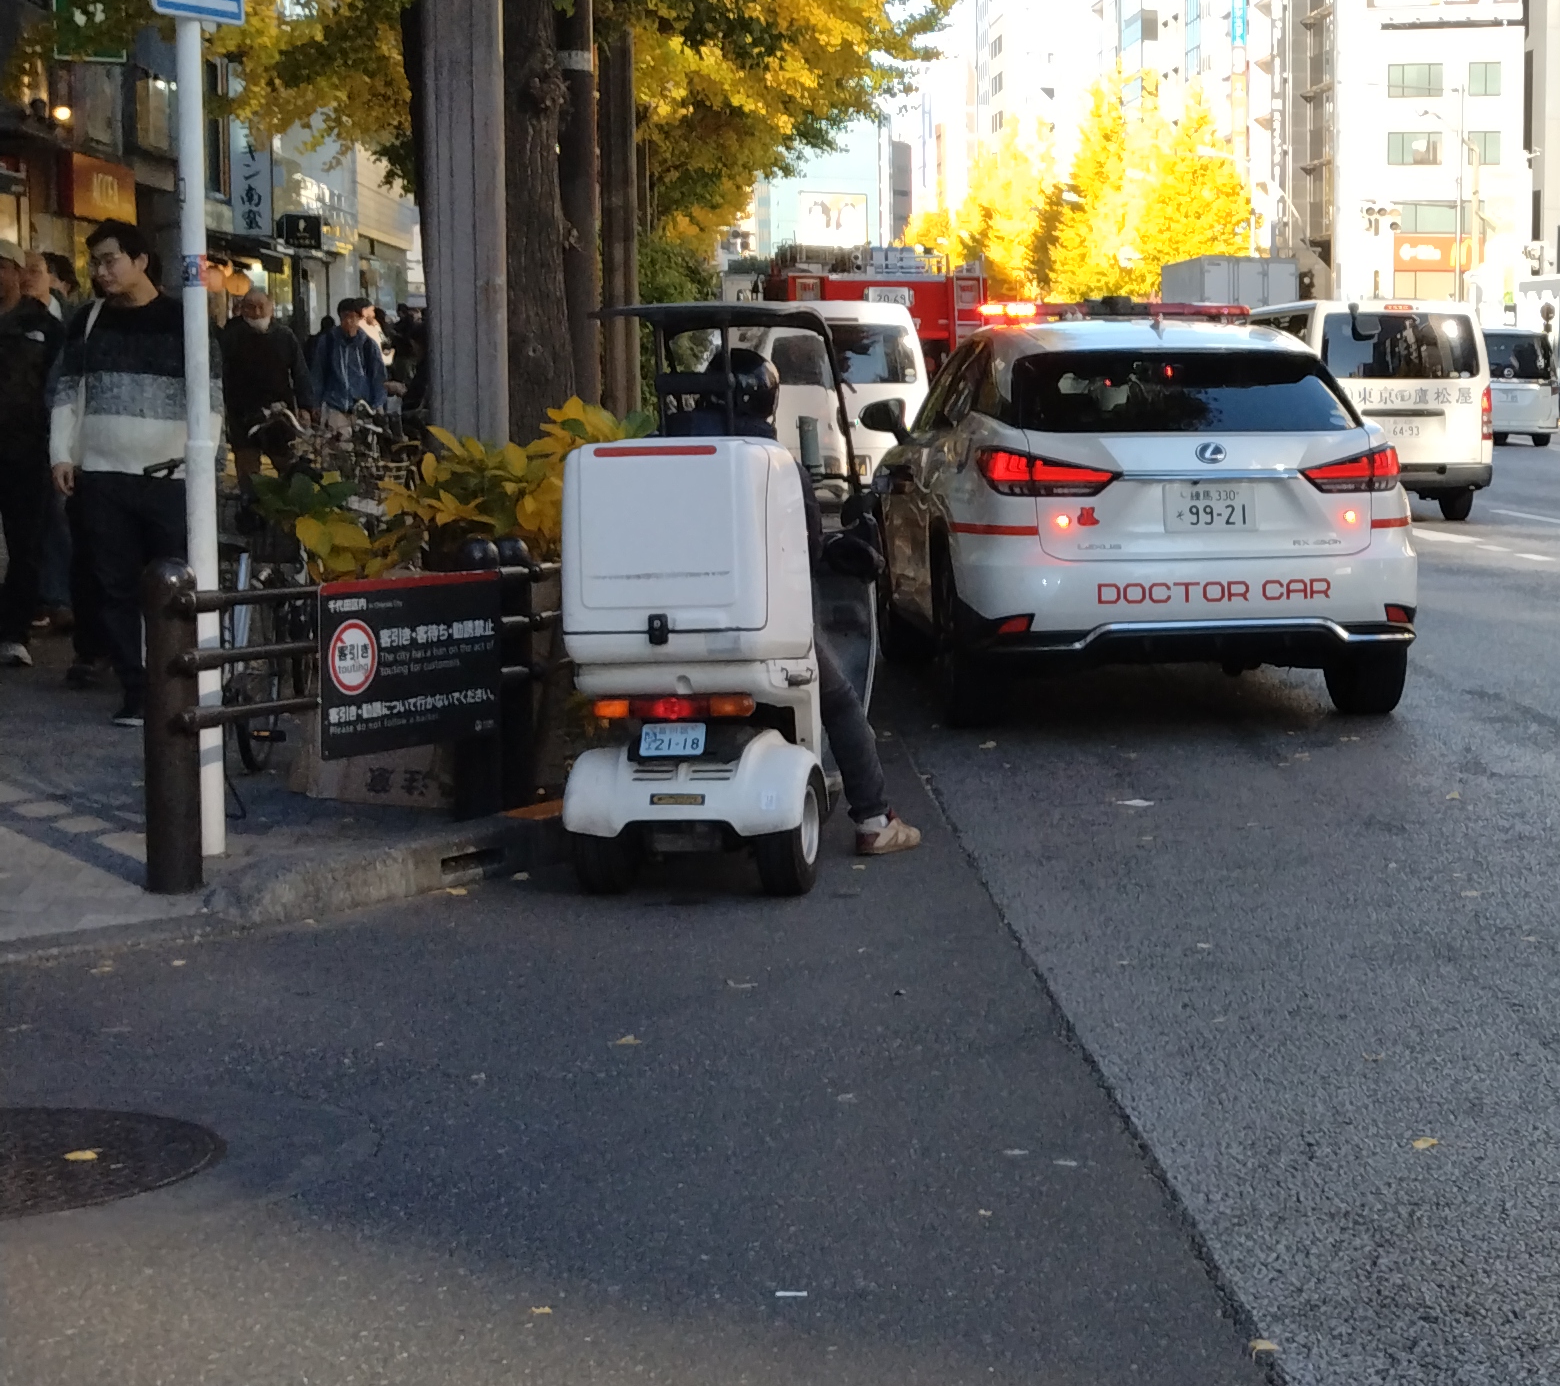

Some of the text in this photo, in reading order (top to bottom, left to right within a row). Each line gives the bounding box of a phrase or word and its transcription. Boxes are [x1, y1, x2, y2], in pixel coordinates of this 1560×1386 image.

[1392, 425, 1420, 436] 64-93
[1190, 489, 1236, 501] 練馬 330
[1188, 503, 1247, 526] 99-21
[1097, 577, 1331, 605] DOCTOR CAR
[337, 642, 370, 662] 客引き
[380, 651, 395, 663] The
[396, 650, 411, 662] city
[337, 662, 369, 675] touting
[410, 661, 421, 672] for
